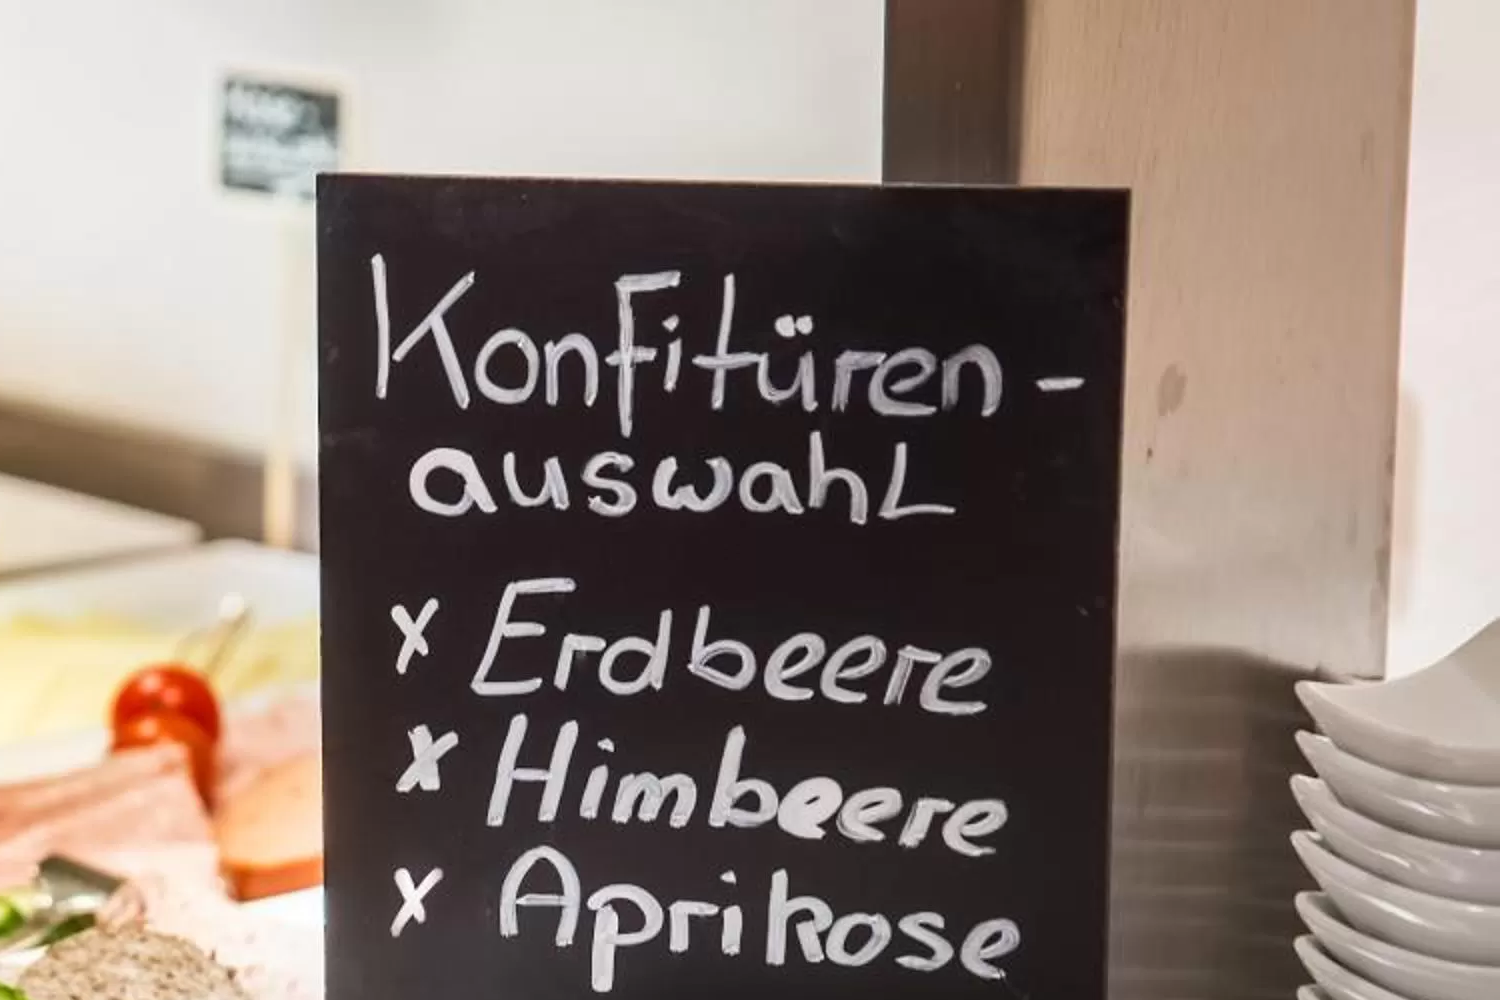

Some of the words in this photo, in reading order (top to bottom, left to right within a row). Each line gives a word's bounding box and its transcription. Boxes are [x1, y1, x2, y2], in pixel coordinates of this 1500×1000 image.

[470, 577, 992, 716] Erdbeere
[486, 713, 1008, 857] Himbeere
[499, 845, 1020, 993] Aprikose
